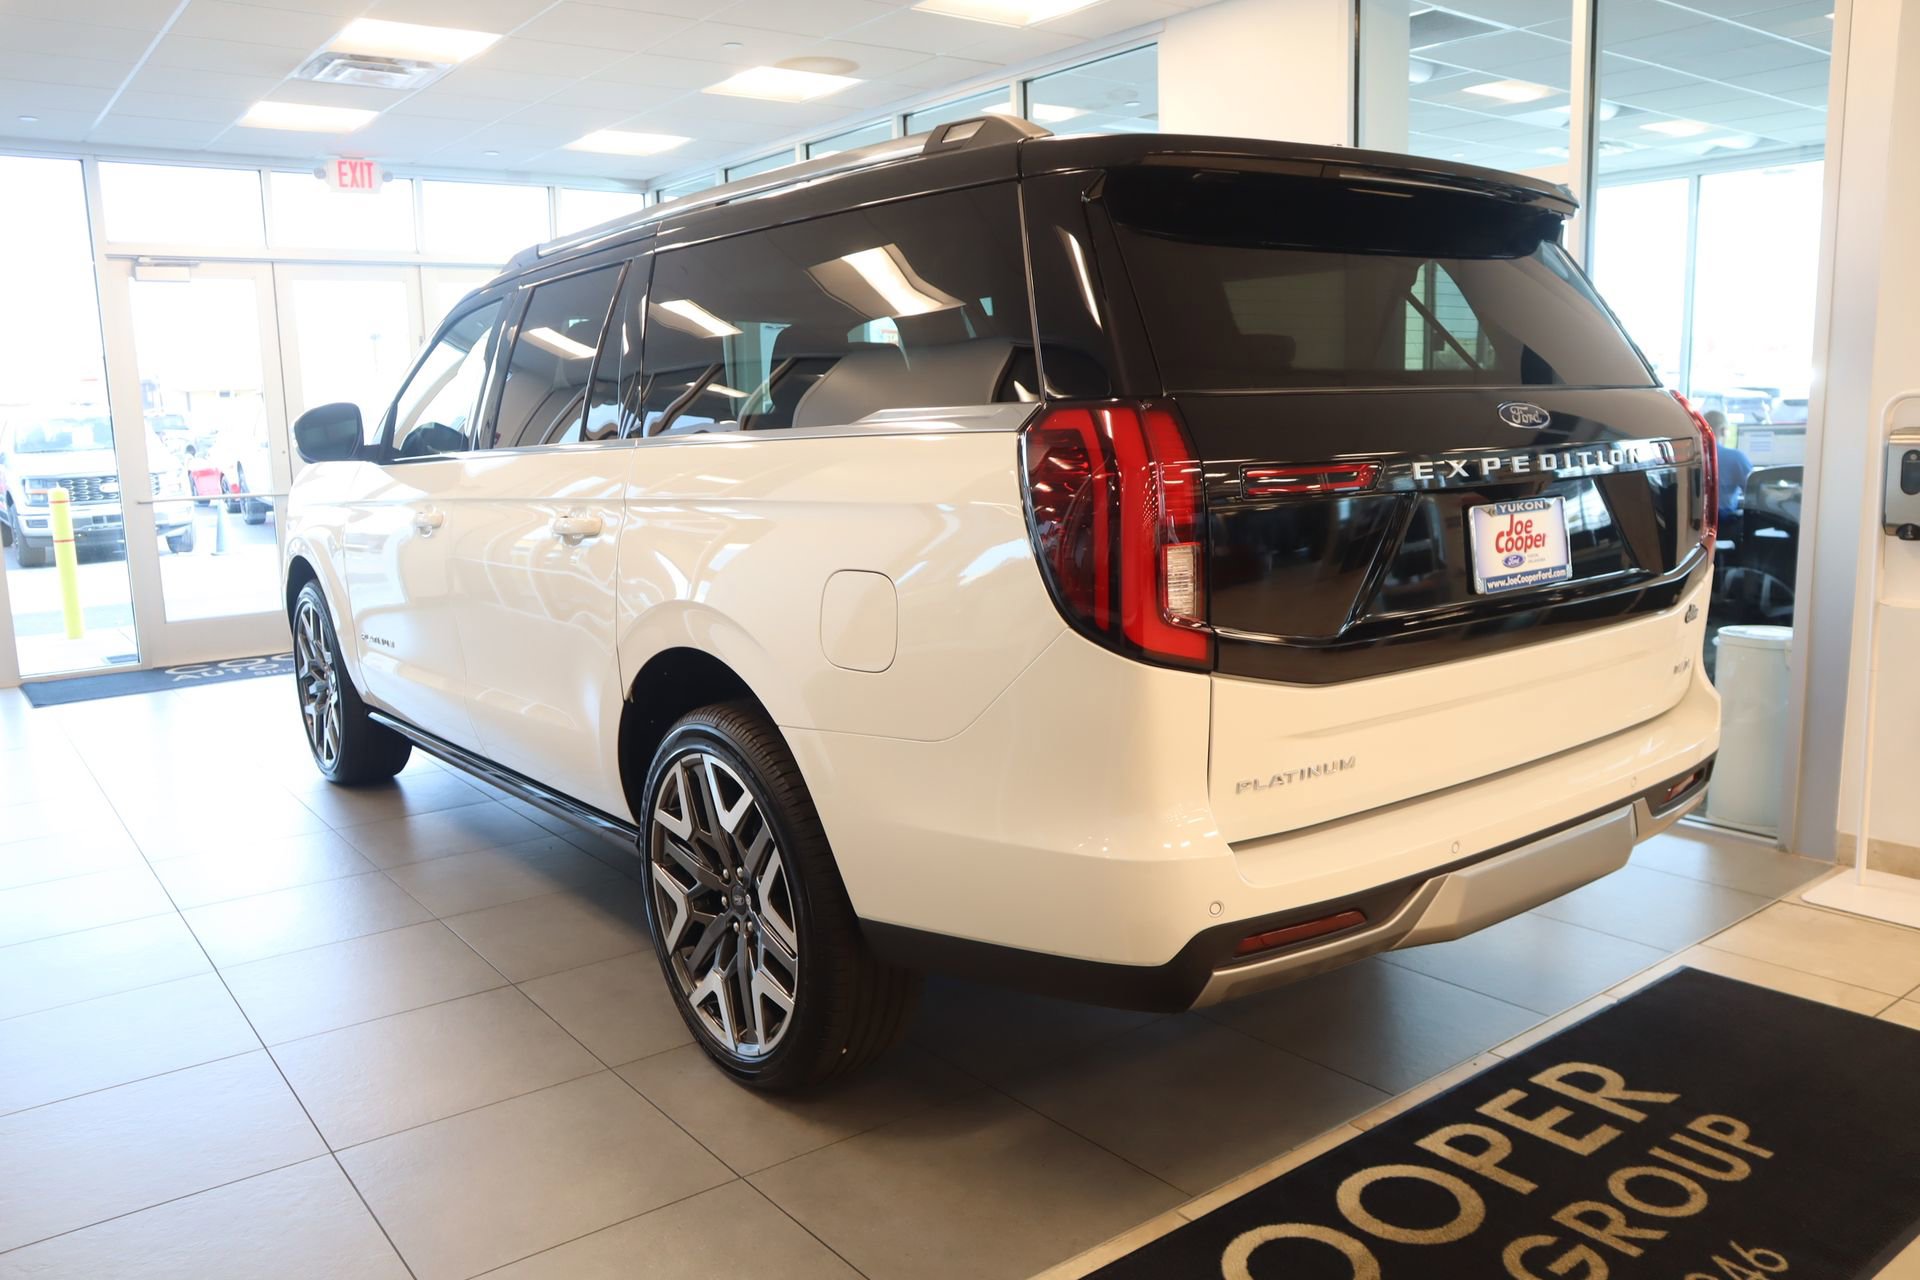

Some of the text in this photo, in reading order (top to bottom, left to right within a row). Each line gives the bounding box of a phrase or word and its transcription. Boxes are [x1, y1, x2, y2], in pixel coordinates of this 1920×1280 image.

[337, 160, 374, 189] EXIT
[1508, 405, 1543, 424] Ford
[1411, 447, 1643, 480] EXPEDITION
[1499, 501, 1544, 513] YUKON
[1506, 513, 1533, 537] Joe
[1495, 532, 1547, 554] Cooper
[1487, 568, 1567, 590] www.JoeCooperFord.com
[171, 663, 279, 682] AUTO
[1235, 755, 1357, 795] PLATINUM
[1502, 1114, 1775, 1280] GROUP
